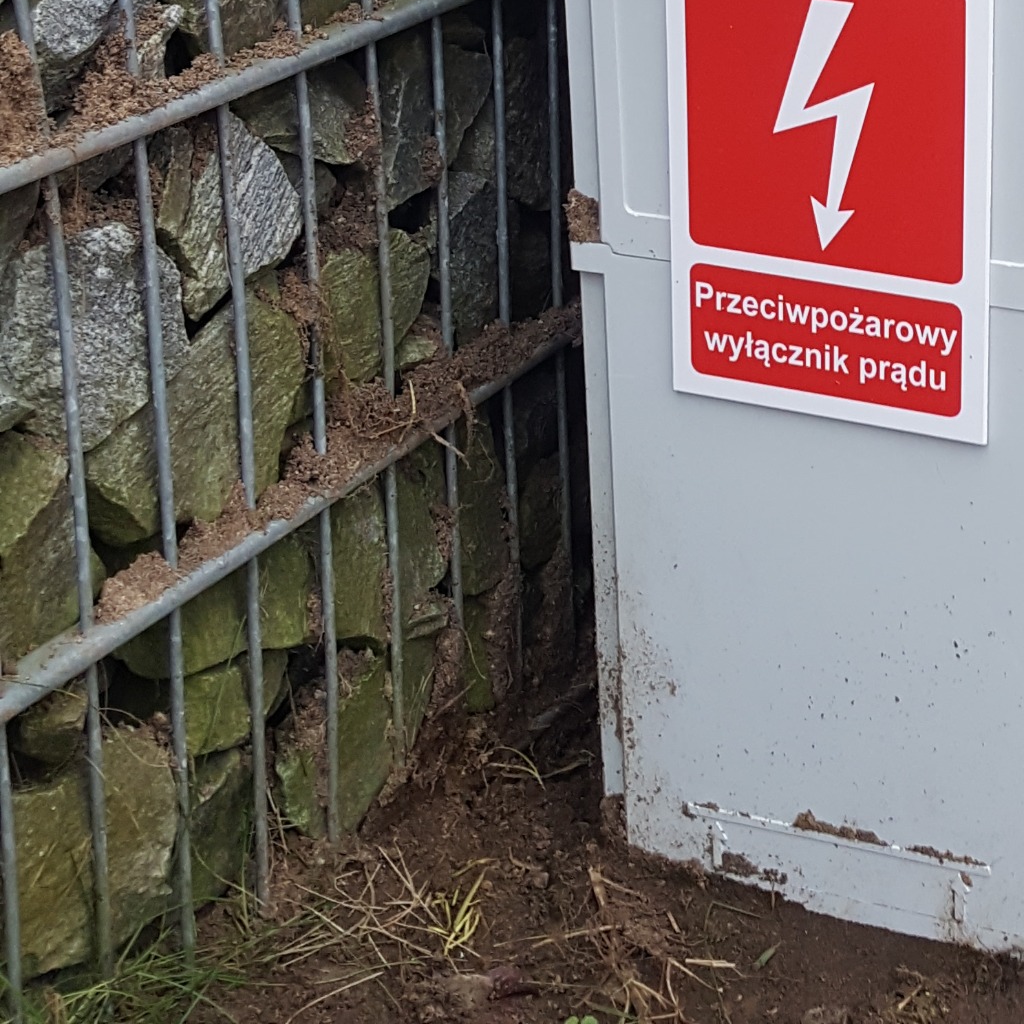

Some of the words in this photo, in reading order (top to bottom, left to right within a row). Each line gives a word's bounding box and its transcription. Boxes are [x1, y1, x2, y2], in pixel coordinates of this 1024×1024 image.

[694, 281, 958, 356] Przeciwpożarowy
[704, 330, 849, 374] wyłącznik
[859, 356, 946, 391] prądu
